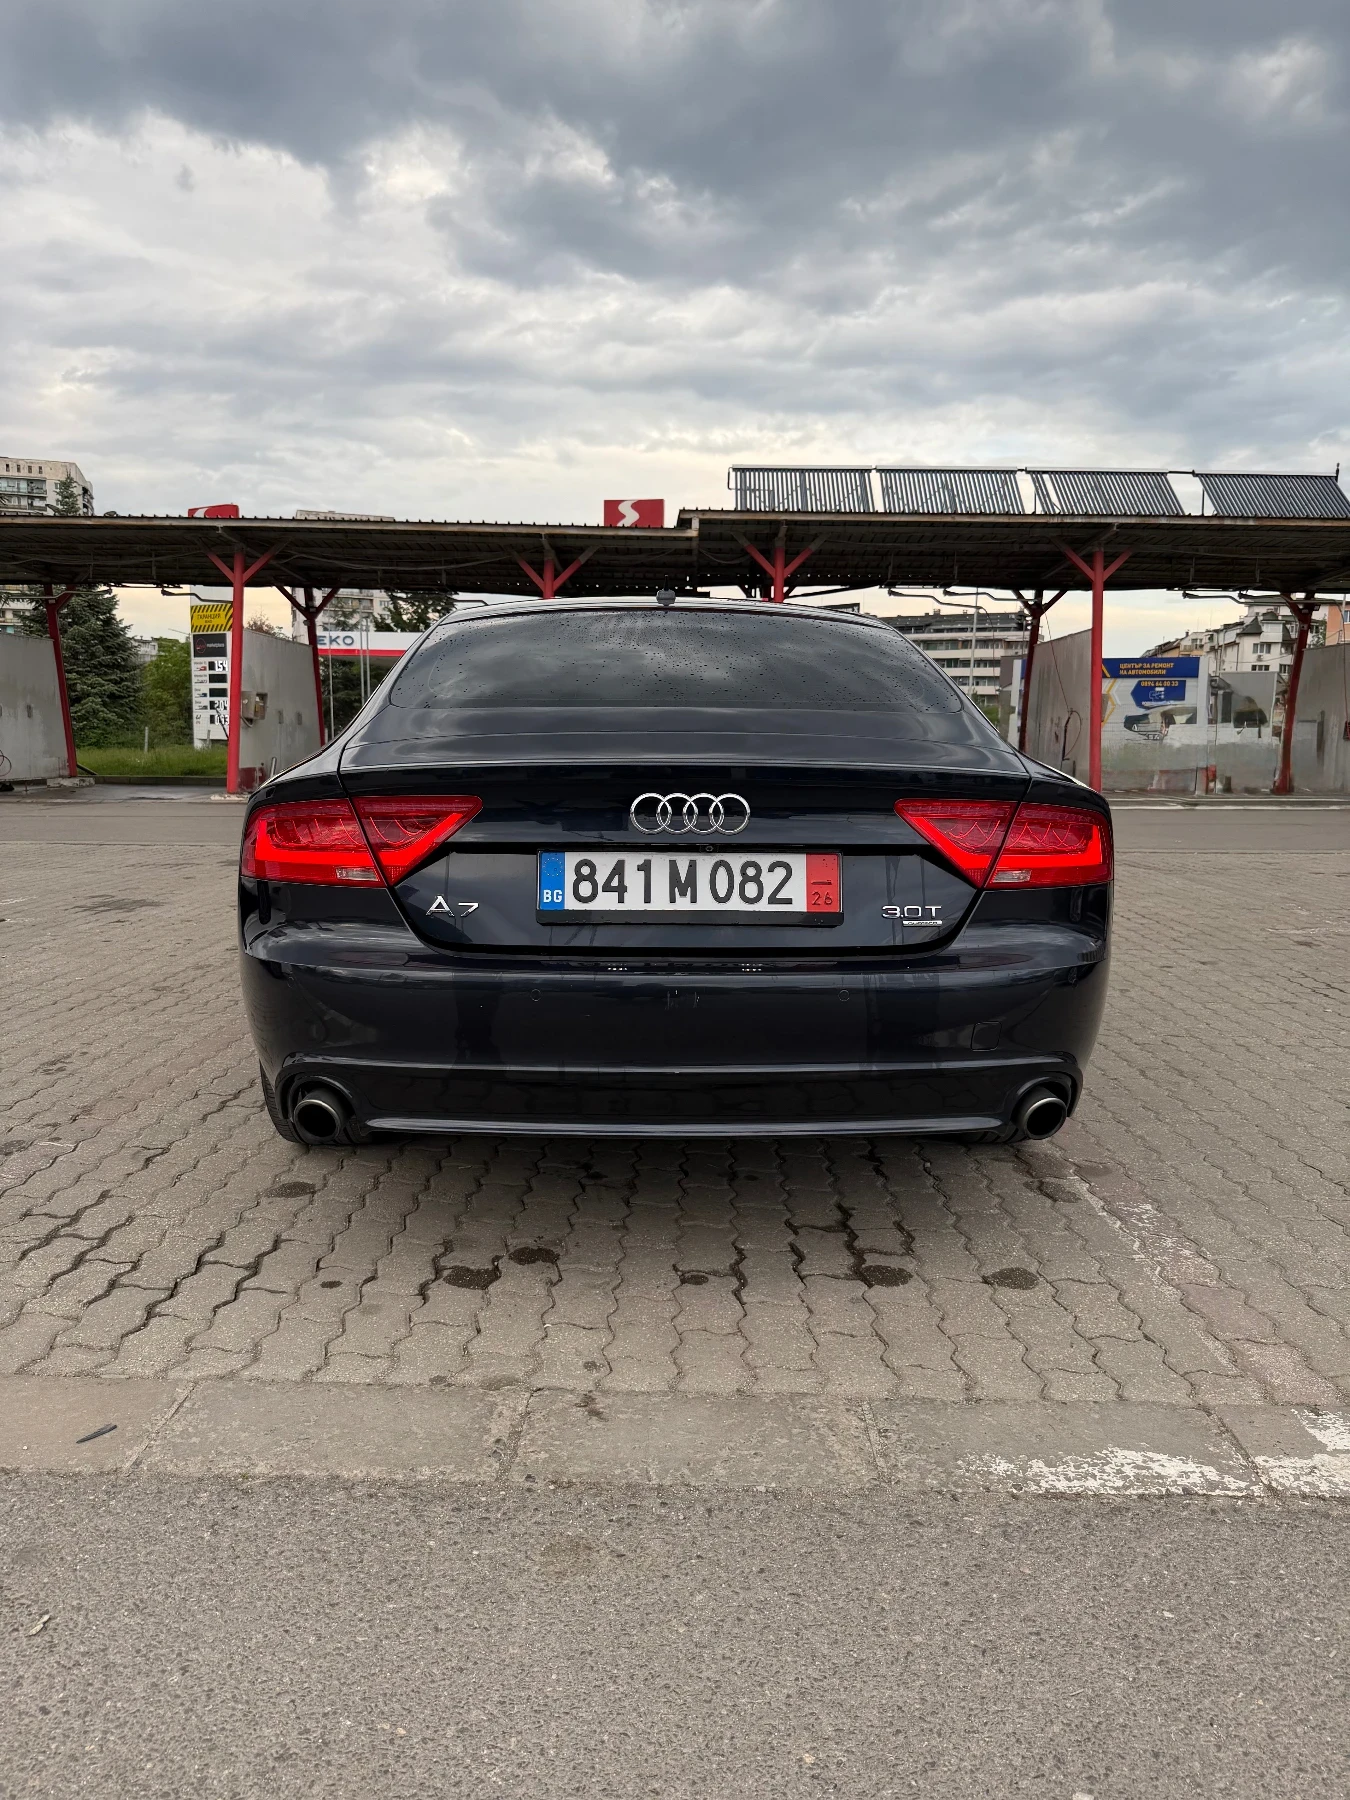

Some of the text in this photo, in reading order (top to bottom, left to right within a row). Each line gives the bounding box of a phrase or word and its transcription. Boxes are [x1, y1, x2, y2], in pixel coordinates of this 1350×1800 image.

[317, 635, 355, 646] EKO
[543, 889, 563, 903] BG
[811, 891, 833, 905] 26
